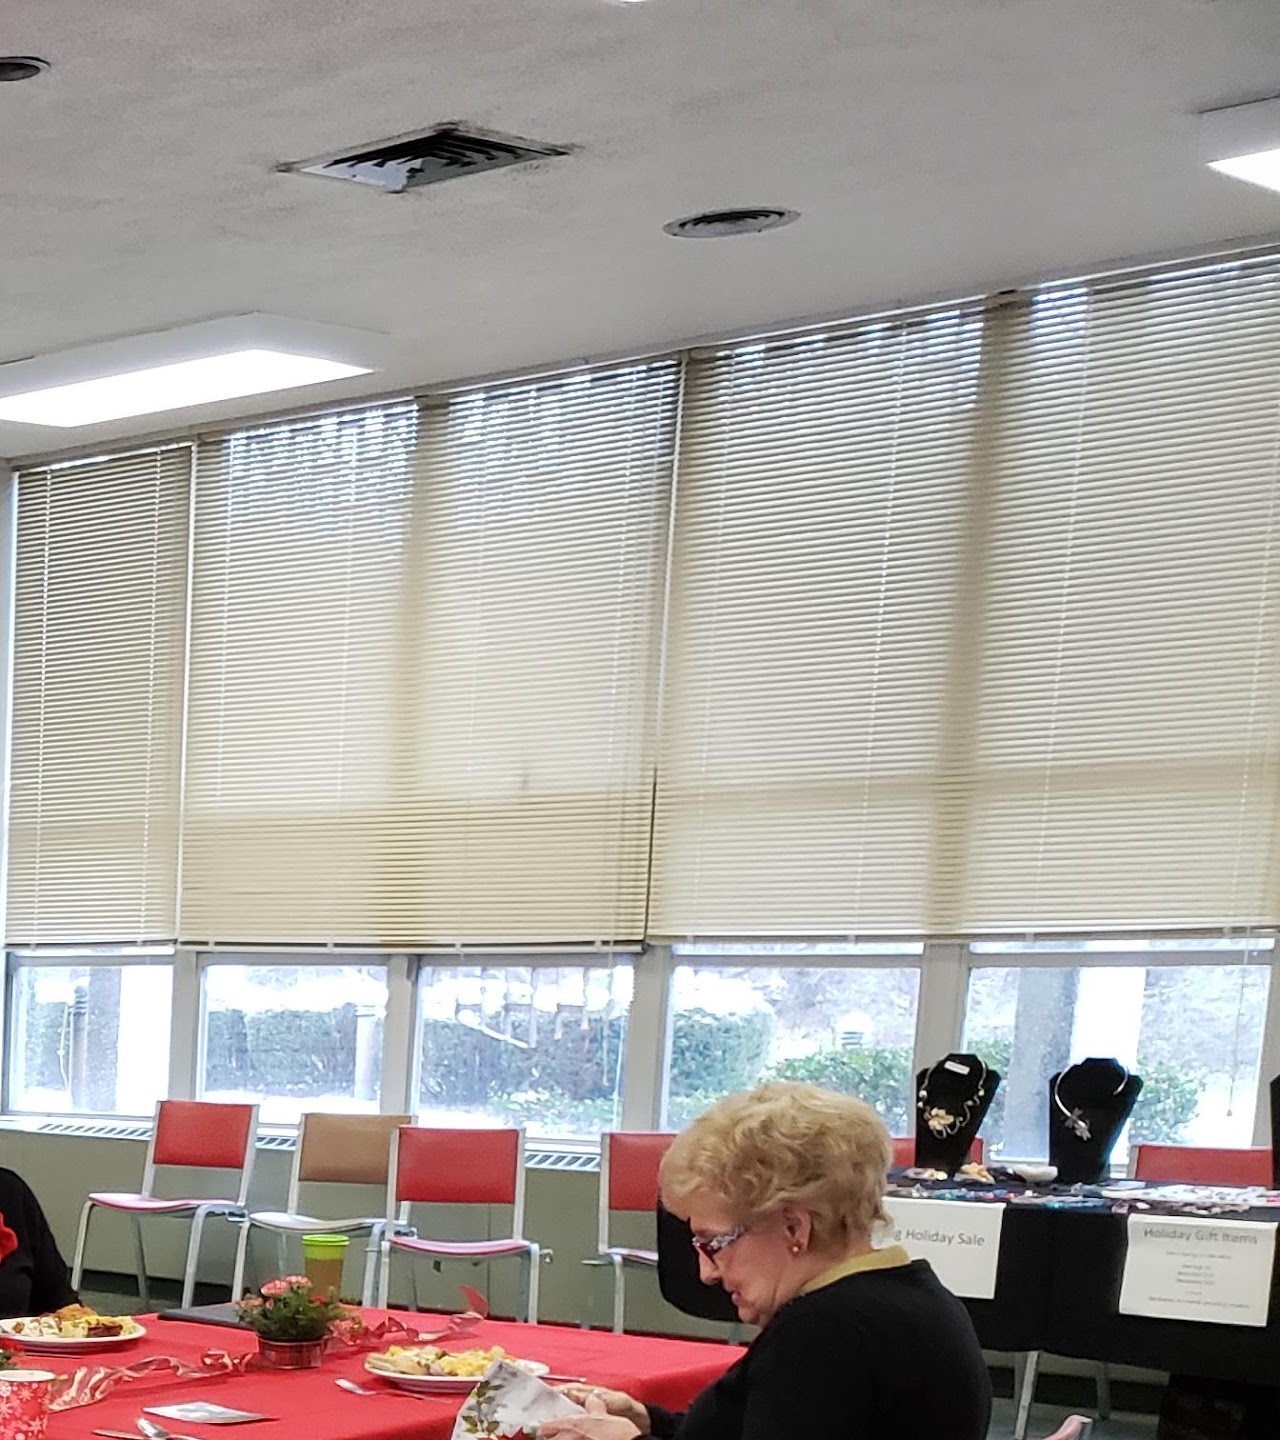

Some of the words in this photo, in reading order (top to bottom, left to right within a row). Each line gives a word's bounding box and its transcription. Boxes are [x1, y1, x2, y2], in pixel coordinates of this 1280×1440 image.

[905, 1229, 955, 1246] Holiday
[957, 1232, 985, 1247] Sale
[1143, 1228, 1192, 1241] Holiday
[1195, 1229, 1218, 1242] Gift
[1222, 1232, 1258, 1245] Items
